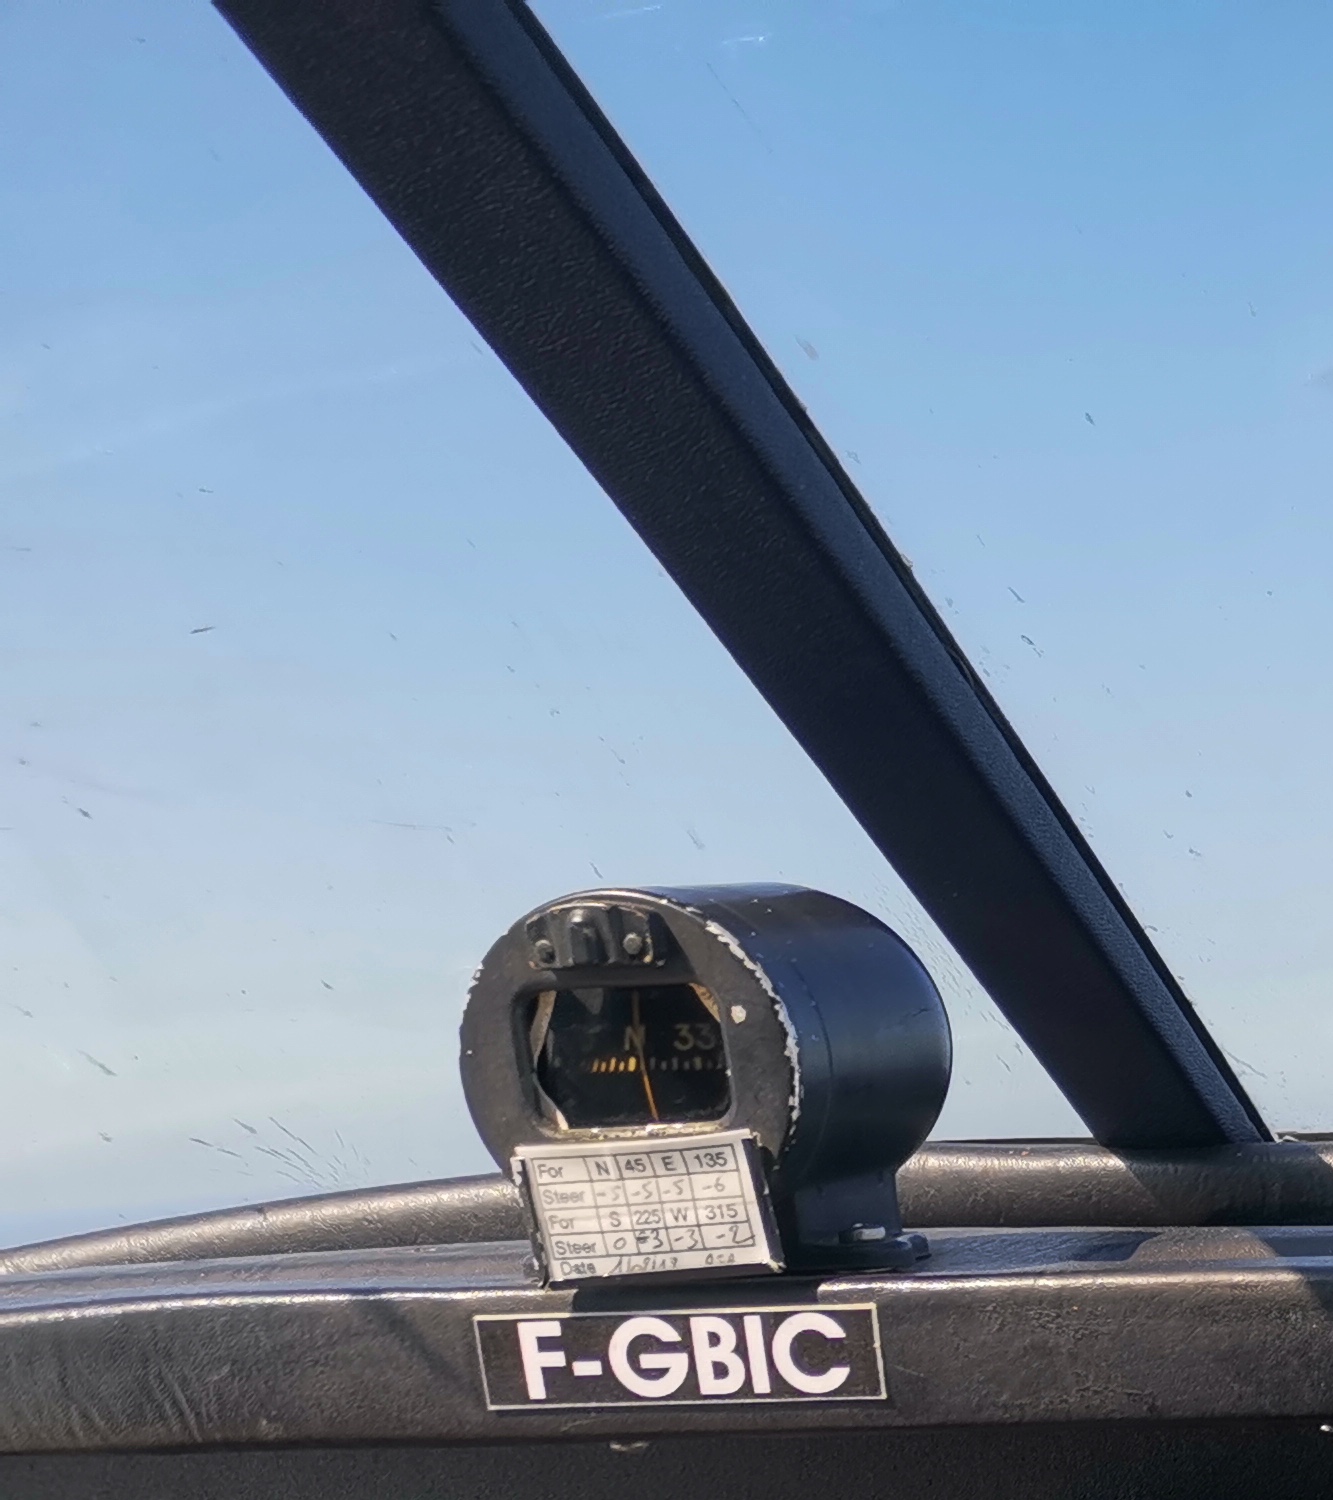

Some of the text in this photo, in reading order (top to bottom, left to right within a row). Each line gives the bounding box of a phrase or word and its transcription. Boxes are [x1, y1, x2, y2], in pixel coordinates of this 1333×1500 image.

[673, 1023, 718, 1051] 33
[538, 1152, 728, 1179] For 45 E 135
[542, 1189, 585, 1204] Steer
[633, 1204, 738, 1224] 225 315
[554, 1241, 596, 1256] Steer
[561, 1260, 596, 1275] Date
[516, 1313, 851, 1399] F-GBIC
